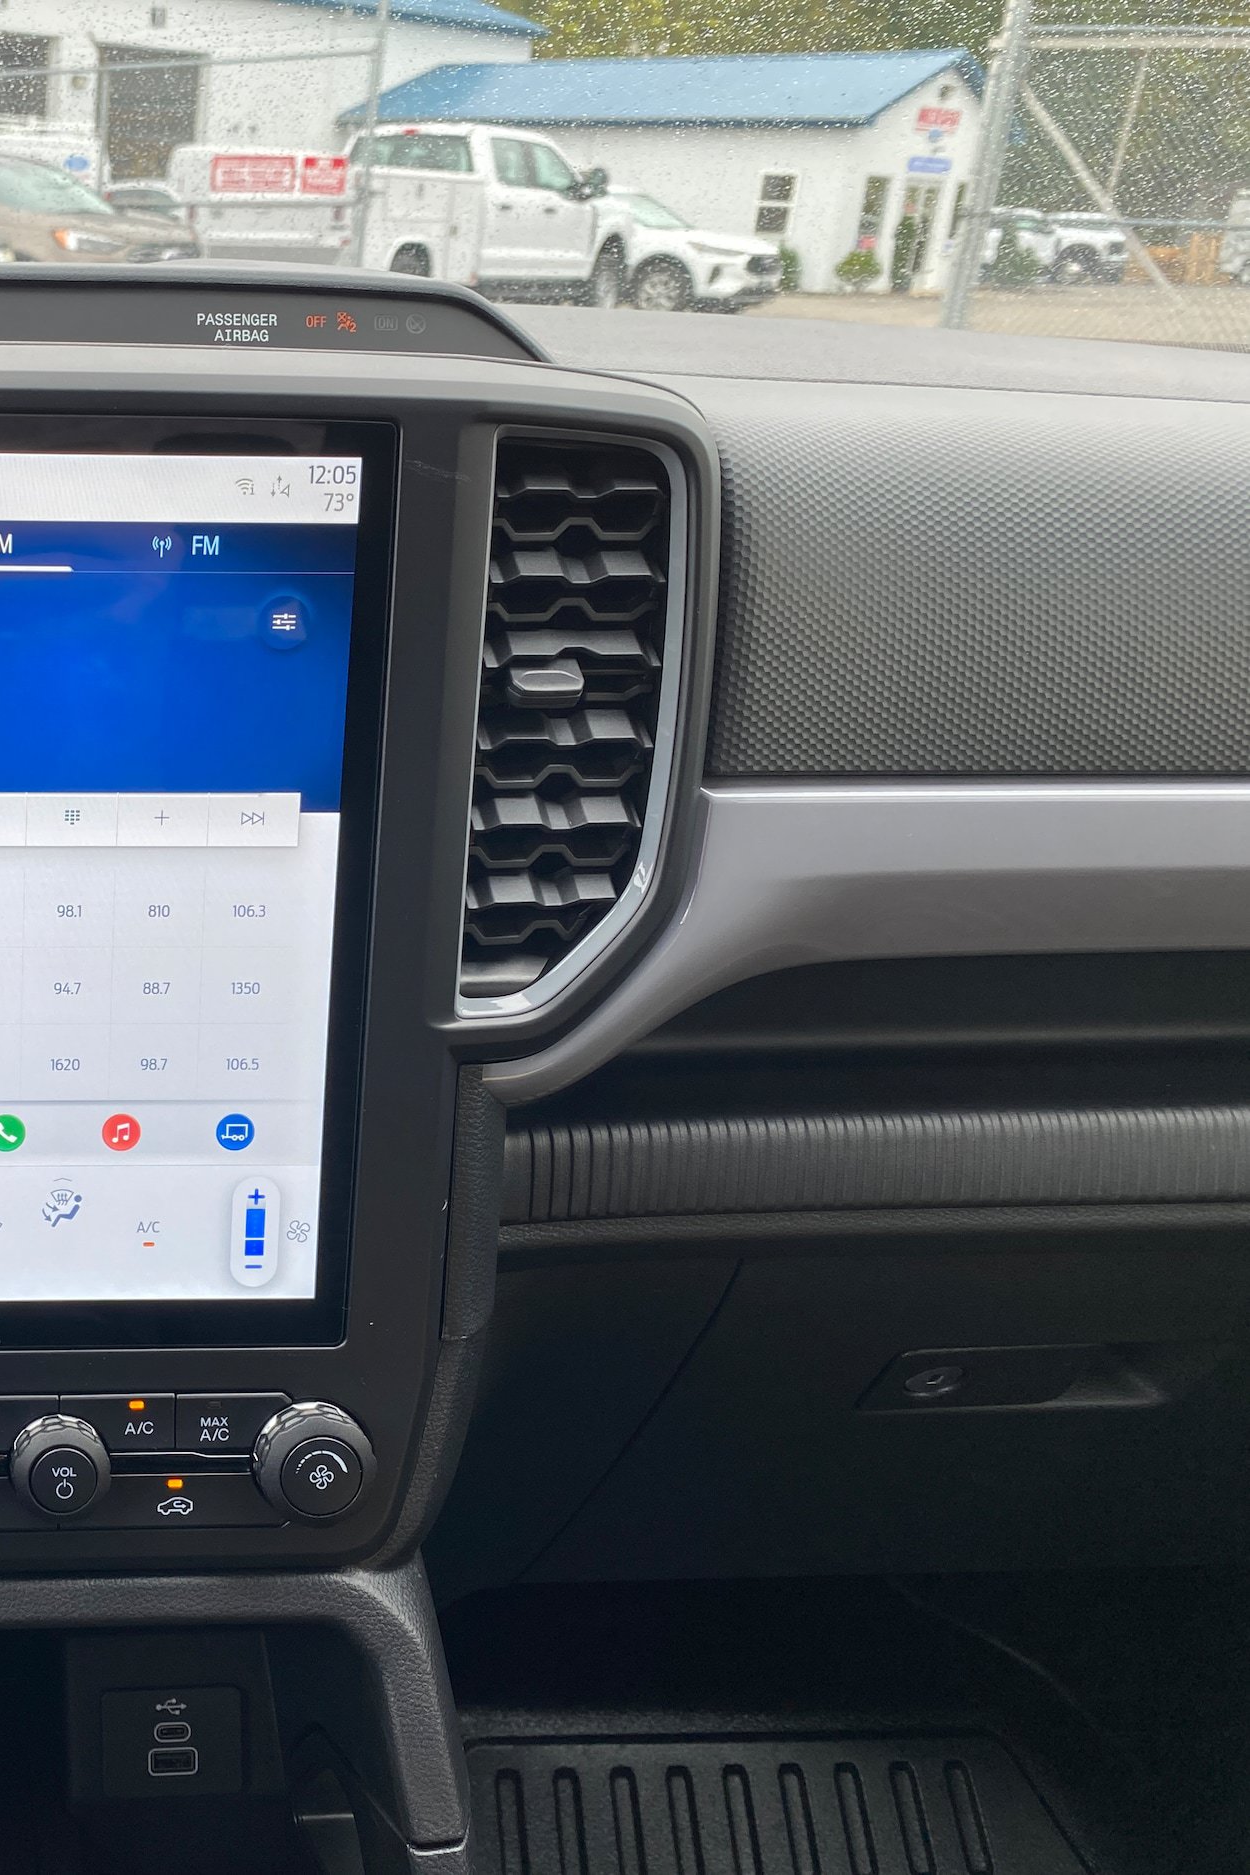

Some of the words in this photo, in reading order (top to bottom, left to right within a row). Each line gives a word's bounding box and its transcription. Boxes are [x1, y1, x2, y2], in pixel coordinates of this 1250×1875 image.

[196, 312, 278, 327] PASSENGER
[305, 315, 327, 329] OFF
[213, 328, 270, 342] AIRBAG
[308, 465, 357, 485] 12:05
[323, 492, 355, 512] 73°
[191, 535, 220, 556] FM
[56, 904, 83, 918] 98.1
[148, 904, 171, 918] 810
[232, 904, 266, 918] 106.3
[53, 982, 82, 996] 94.7
[142, 982, 171, 996] 88.7
[230, 981, 261, 995] 1350
[50, 1058, 81, 1072] 1620
[140, 1058, 168, 1071] 98.7
[226, 1057, 260, 1071] 106.5
[136, 1221, 161, 1235] A/C
[124, 1421, 154, 1435] A/C
[200, 1416, 229, 1427] MAX
[199, 1427, 230, 1442] A/C
[51, 1466, 77, 1478] VOL
